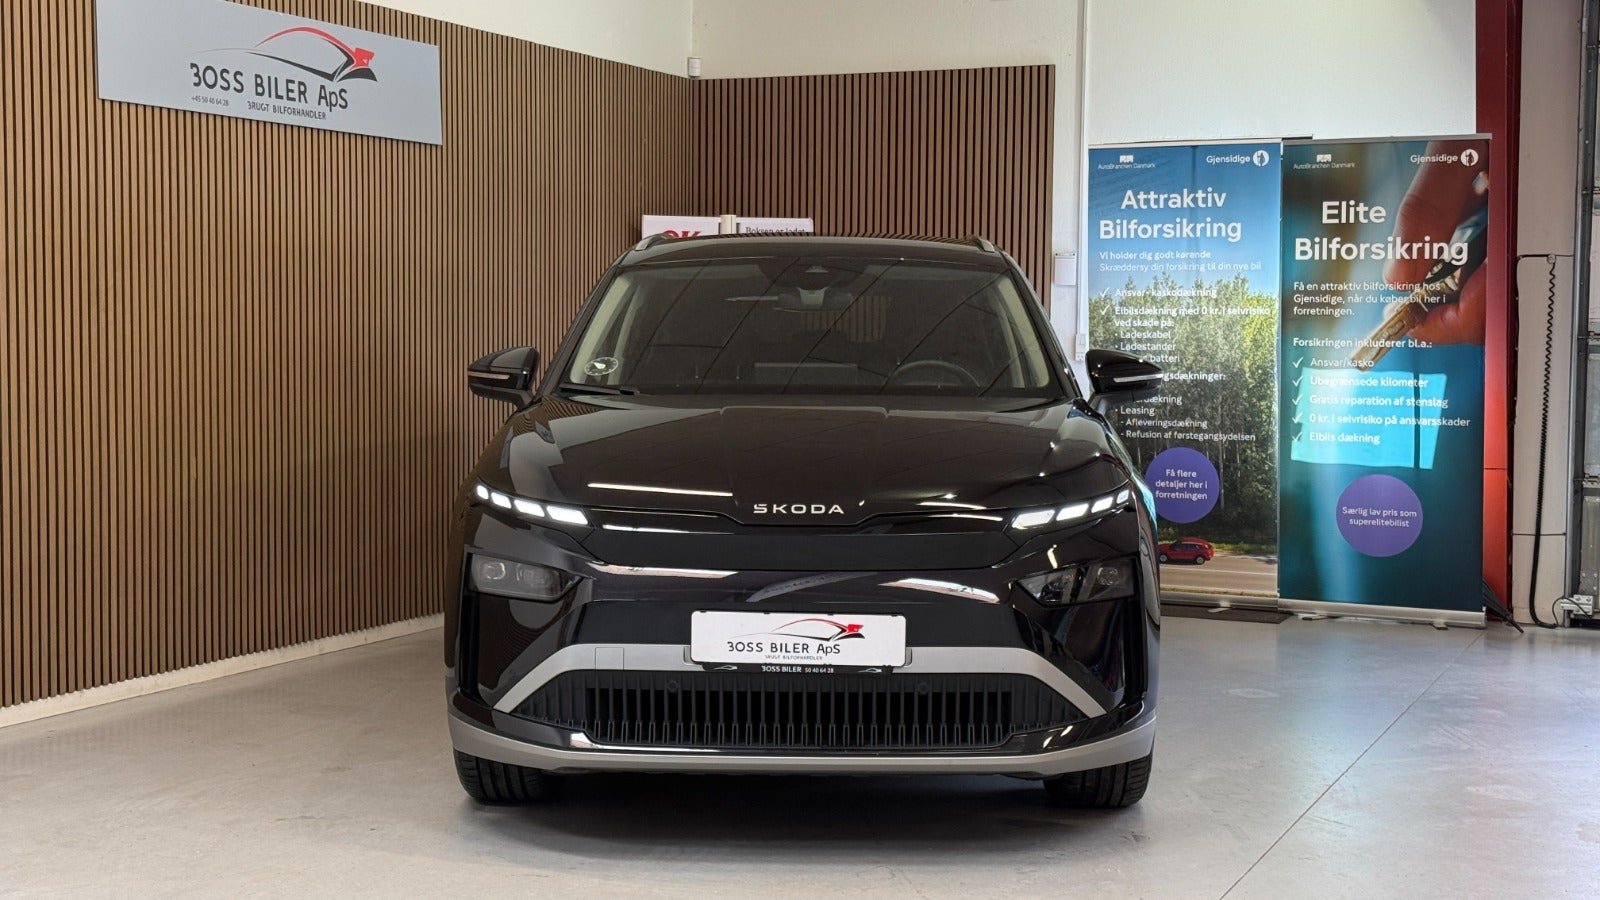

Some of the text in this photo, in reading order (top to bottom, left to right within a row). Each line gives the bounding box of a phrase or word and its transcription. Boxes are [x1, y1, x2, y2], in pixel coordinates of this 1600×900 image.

[254, 73, 308, 104] BILER
[317, 84, 348, 112] ApS
[272, 105, 326, 120] BILFORHANDLER
[1206, 154, 1250, 166] Gjensidige
[1410, 154, 1458, 164] Gjensidige
[1120, 187, 1227, 210] Attraktiv
[1322, 200, 1387, 224] Elite
[1099, 217, 1242, 243] Bilforsikring
[1100, 250, 1211, 262] Vi holder dig godt kørende
[1295, 236, 1469, 266] Bilforsikring
[1100, 261, 1262, 272] Skræddersy din forsikring til din nye bil
[1152, 288, 1218, 299] kaskodækning
[1294, 282, 1304, 290] Få
[1320, 282, 1361, 291] attraktiv
[1363, 282, 1420, 293] bilforsikring
[1422, 282, 1440, 292] hos
[1294, 294, 1345, 305] Gjensidige,
[1348, 293, 1362, 304] når
[1365, 294, 1378, 304] du
[1380, 294, 1406, 304] køber
[1409, 294, 1422, 304] bil
[1424, 294, 1440, 304] her
[1115, 306, 1177, 317] Elbilsdækning
[1180, 306, 1199, 316] med
[1202, 307, 1208, 316] 0
[1210, 306, 1221, 316] kr.
[1228, 306, 1270, 316] selvrisiko
[1294, 306, 1354, 318] forretningen.
[1115, 320, 1131, 328] ved
[1132, 320, 1159, 328] skade
[1120, 330, 1171, 340] Ladeskabel
[1120, 342, 1176, 351] Ladestander
[1293, 338, 1352, 349] Forsikringen
[1355, 338, 1405, 348] inkluderer
[1310, 357, 1374, 368] Ansvar/kasko
[1162, 370, 1226, 383] gsdækninger:
[1310, 377, 1428, 389] Ubegrænsede kilometer
[1310, 396, 1448, 408] Gratis reparation af stenslag
[1120, 406, 1155, 416] Leasing
[1126, 418, 1208, 430] Afleveringsdækning
[1310, 414, 1316, 423] 0
[1318, 414, 1330, 424] kr.
[1336, 414, 1382, 425] selvrisiko
[1384, 414, 1397, 428] på
[1400, 416, 1470, 428] ansvarsskader
[1126, 430, 1162, 438] Refusion
[1164, 430, 1172, 439] af
[1310, 432, 1380, 445] Elbils dækning
[1166, 468, 1196, 478] Få flere
[1156, 480, 1188, 490] detaljer
[1189, 480, 1203, 488] her
[1156, 490, 1208, 502] forretningen
[1342, 506, 1368, 517] Særlig
[1370, 508, 1381, 516] lav
[1382, 508, 1398, 517] pris
[1349, 518, 1410, 528] superelitebilist
[770, 642, 809, 654] BILER
[816, 644, 840, 656] ApS
